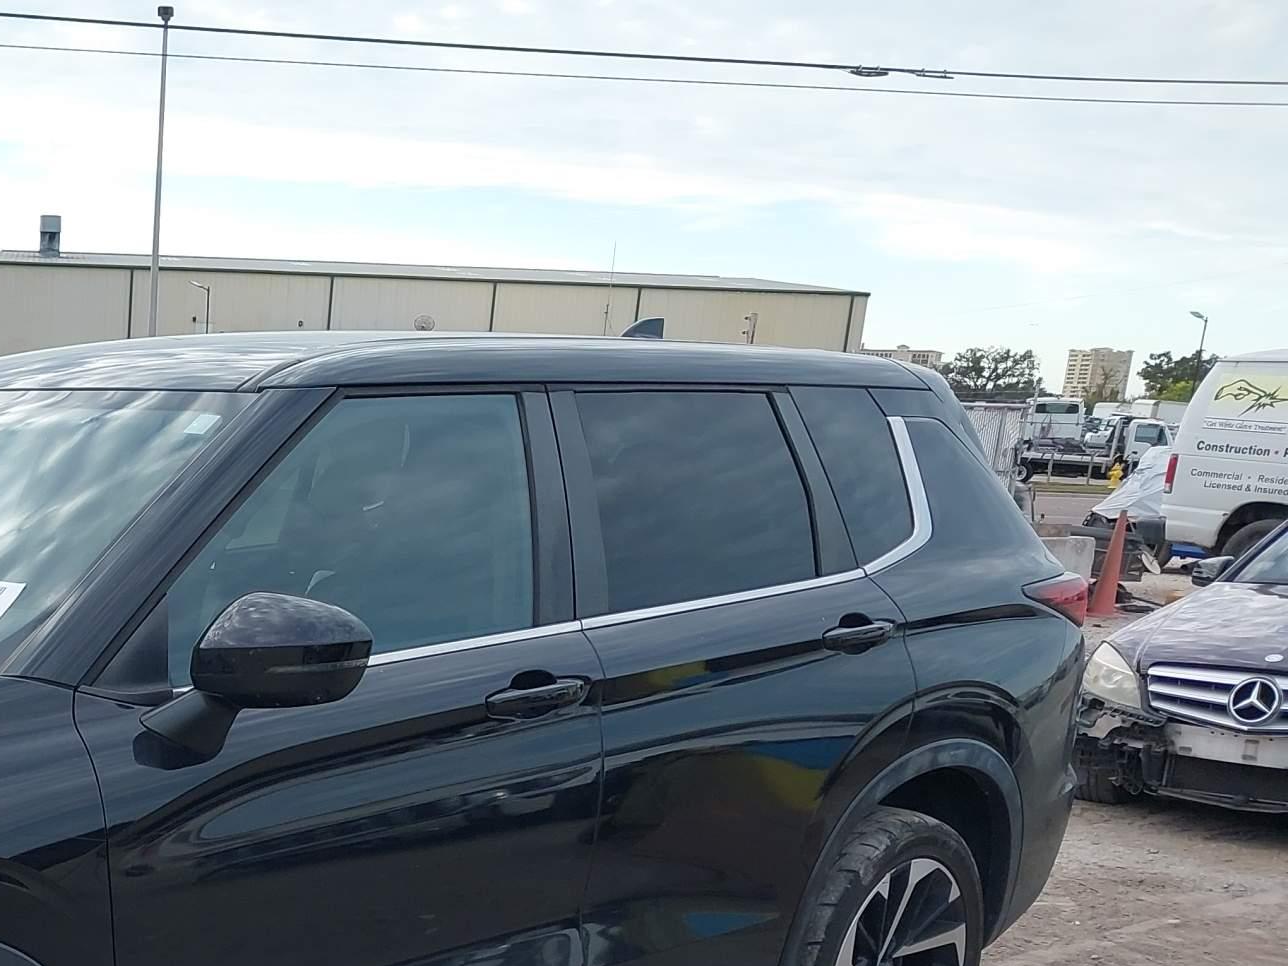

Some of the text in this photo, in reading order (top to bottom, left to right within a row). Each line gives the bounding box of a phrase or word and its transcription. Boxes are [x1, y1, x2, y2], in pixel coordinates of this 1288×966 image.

[1196, 440, 1271, 457] Construction
[1190, 468, 1243, 481] Commercial
[1203, 480, 1244, 491] Licensed
[1244, 484, 1252, 492] &
